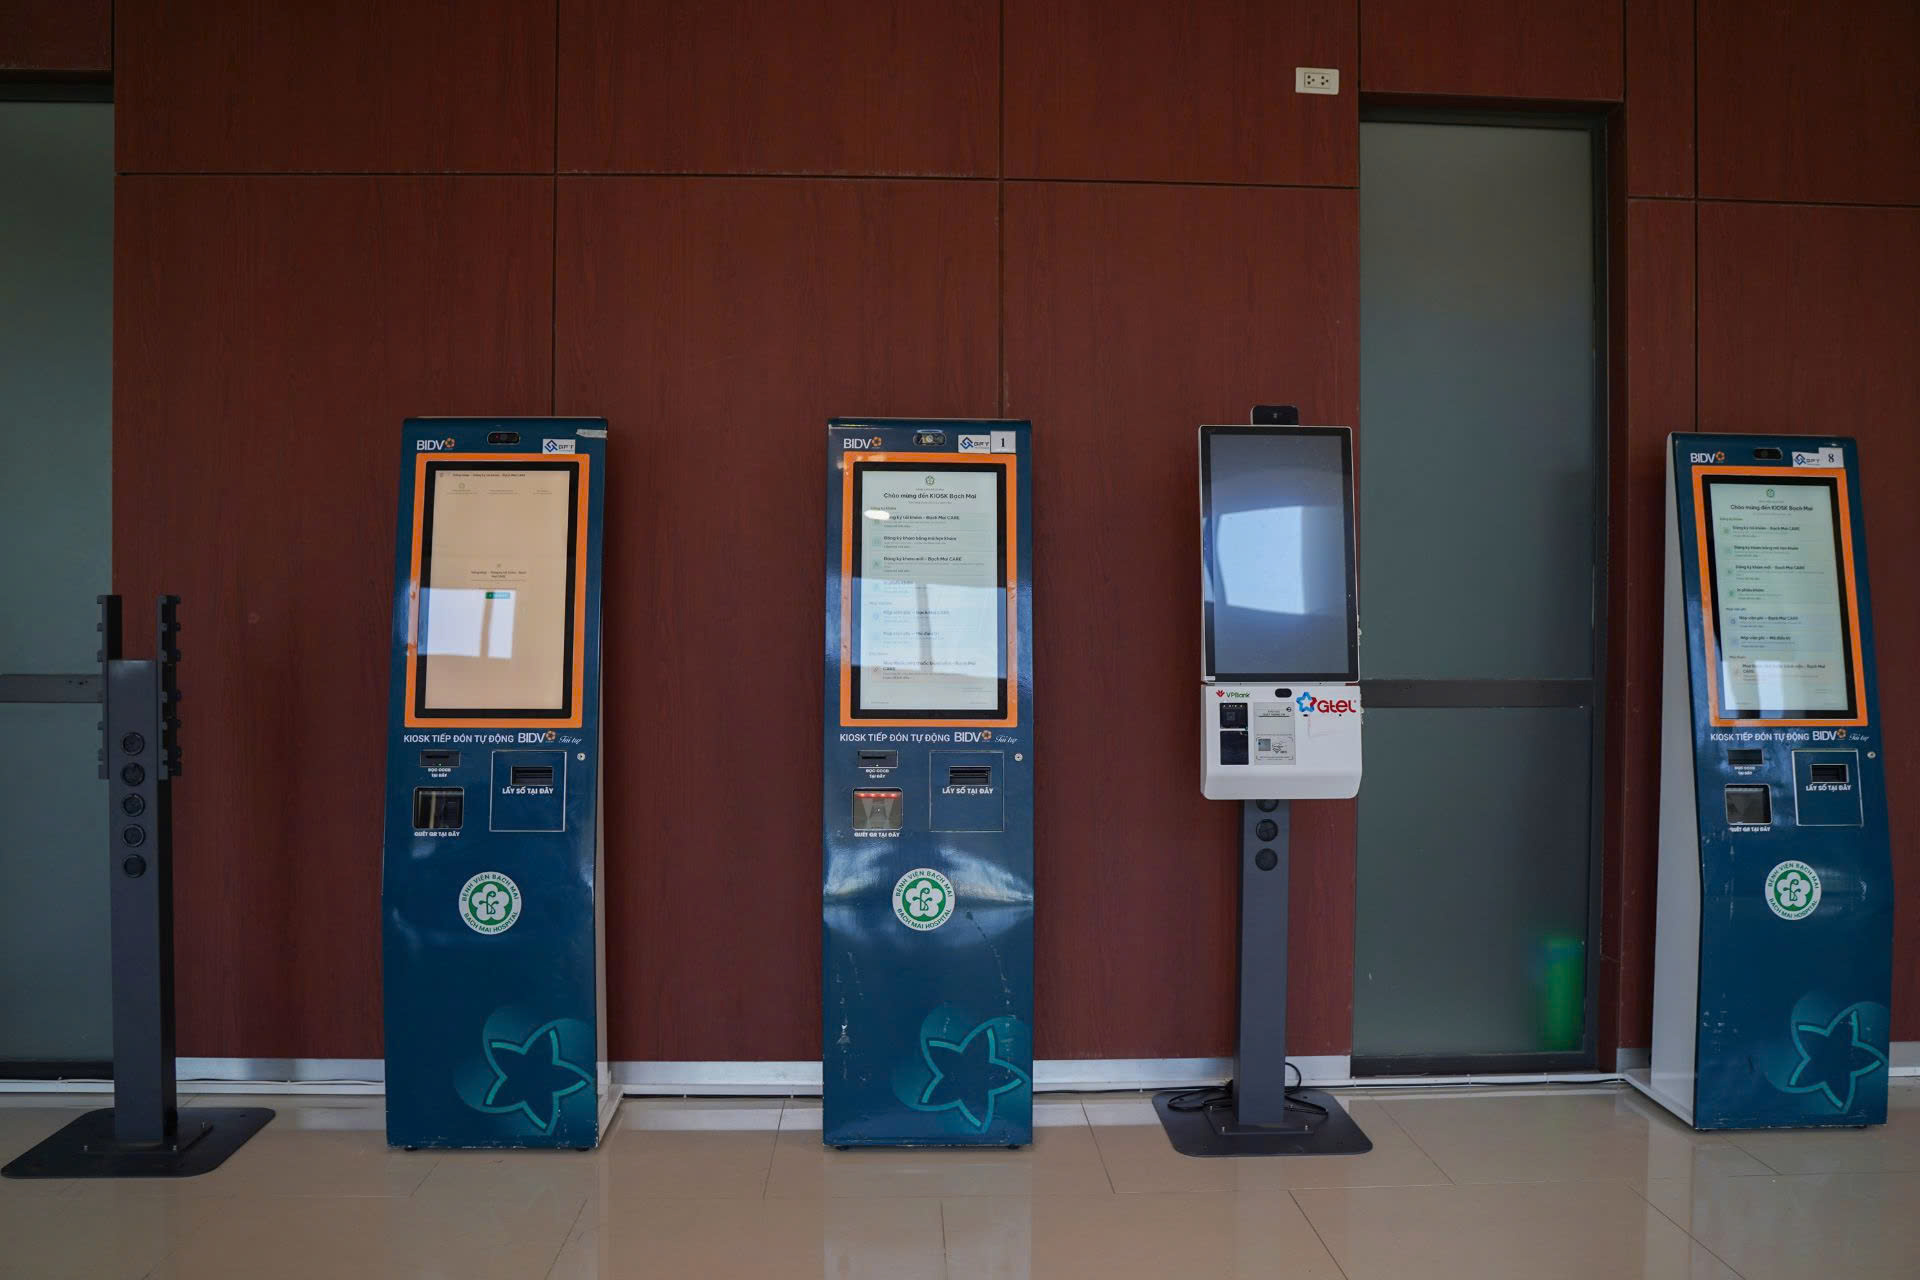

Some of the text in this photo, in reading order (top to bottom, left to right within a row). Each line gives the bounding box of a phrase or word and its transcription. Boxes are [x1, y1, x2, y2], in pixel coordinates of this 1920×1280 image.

[416, 439, 445, 450] BIDV
[843, 438, 872, 449] BIDV
[1000, 437, 1005, 447] 1
[1690, 452, 1715, 464] BIDV
[1828, 453, 1835, 463] 8
[1317, 699, 1357, 713] Gtel
[403, 734, 430, 743] KIOSK
[432, 732, 451, 743] TIẾP
[453, 732, 472, 743] ĐÓN
[474, 734, 487, 745] TỰ
[488, 732, 514, 745] ĐỘNG
[518, 732, 545, 743] BIDV
[839, 733, 866, 742] KIOSK
[867, 731, 888, 742] TIẾP
[889, 732, 909, 742] ĐÓN
[910, 733, 924, 744] TỰ
[924, 732, 950, 744] ĐỘNG
[954, 732, 981, 743] BIDV
[1710, 733, 1734, 741] KIOSK
[1735, 731, 1753, 741] TIẾP
[1754, 731, 1771, 741] ĐÓN
[1773, 733, 1786, 743] TỰ
[1786, 732, 1809, 743] ĐỘNG
[1812, 730, 1837, 741] BIDV
[502, 786, 515, 795] LẤY
[516, 786, 526, 794] SỐ
[527, 788, 538, 796] TẠI
[942, 785, 994, 796] LẤY SỐ TẠI ĐÂY
[1806, 784, 1817, 792] LẤY
[1812, 875, 1820, 889] MAI
[510, 885, 519, 900] MAI
[943, 883, 953, 897] MAI
[1793, 900, 1817, 918] HOSPITAL
[478, 925, 492, 933] MAI
[493, 912, 519, 933] HOSPITAL
[911, 921, 924, 929] MAI
[925, 908, 952, 929] HOSPITAL
